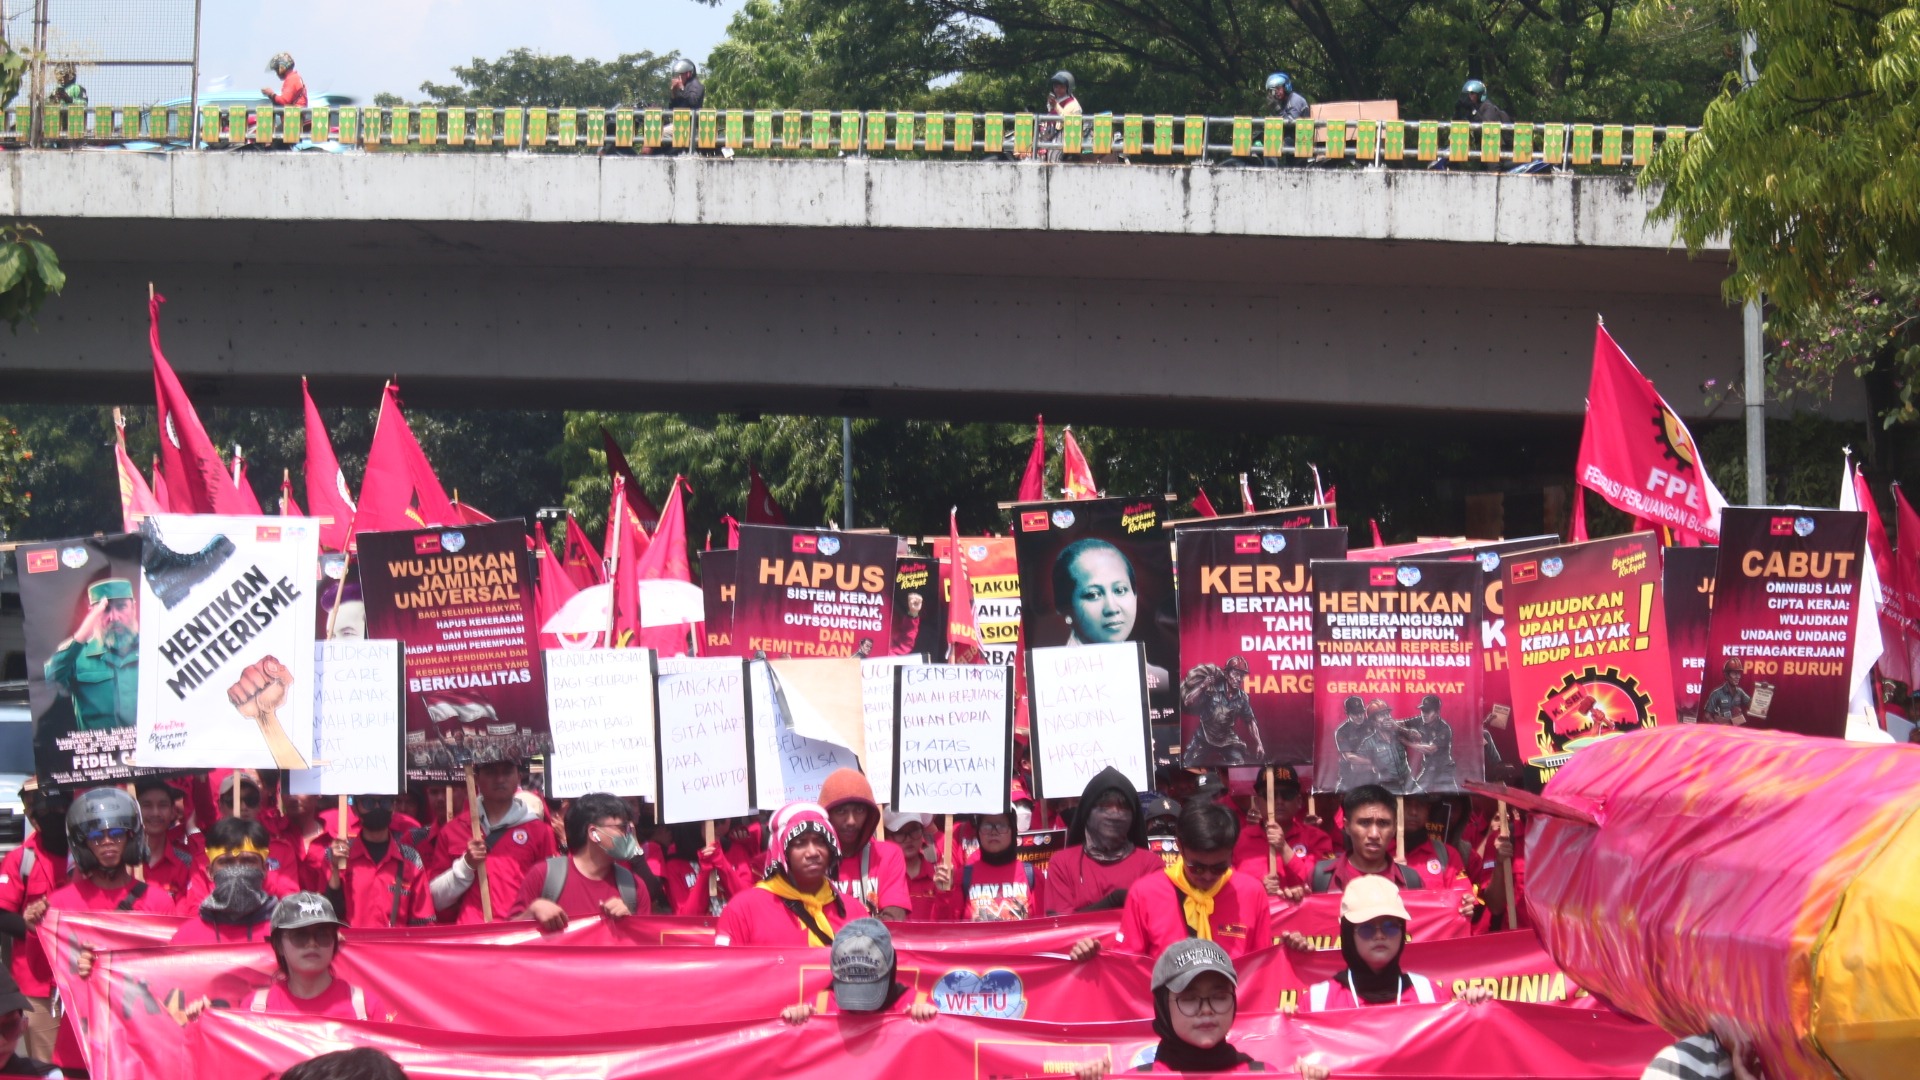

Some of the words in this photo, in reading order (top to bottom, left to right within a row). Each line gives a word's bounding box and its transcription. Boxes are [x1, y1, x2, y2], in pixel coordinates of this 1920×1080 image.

[1123, 502, 1152, 515] MayDay
[1621, 487, 1689, 527] PERJUANGAN
[1121, 510, 1156, 527] Bersama
[1128, 520, 1155, 534] Rakyat
[388, 551, 516, 578] WUJUDKAN
[1612, 551, 1648, 571] Bersama
[1618, 560, 1647, 579] Rakyat
[1742, 550, 1855, 578] CABUT
[418, 567, 518, 592] JAMINAN
[759, 557, 885, 593] HAPUS
[896, 570, 929, 583] Bersama
[901, 579, 927, 590] Rakyat
[1766, 582, 1823, 594] OMNIBUS
[1825, 582, 1852, 595] LAW
[394, 584, 520, 609] UNIVERSAL
[787, 587, 836, 603] SISTEM
[840, 591, 884, 606] KERJA
[1319, 591, 1471, 613] HENTIKAN
[1518, 590, 1625, 621] WUJUDKAN
[1768, 598, 1804, 610] CIPTA
[1807, 598, 1850, 611] KERJA:
[158, 564, 270, 667] HENTIKAN
[418, 610, 440, 620] BAGI
[441, 607, 483, 618] SELURUH
[813, 602, 883, 620] KONTRAK,
[1327, 613, 1464, 627] PEMBERANGUSAN
[1779, 614, 1848, 626] WUJUDKAN
[436, 619, 468, 630] HAPUS
[469, 614, 524, 627] KEKERASAN
[784, 613, 882, 631] OUTSOURCING
[1519, 615, 1565, 637] UPAH
[1568, 609, 1625, 631] LAYAK
[166, 575, 302, 701] MILITERISME
[442, 630, 462, 640] DAN
[463, 625, 525, 639] DISKRIMINASI
[819, 628, 855, 644] DAN
[1332, 627, 1397, 640] SERIKAT
[1401, 627, 1459, 642] BURUH,
[1520, 631, 1570, 652] KERJA
[1574, 623, 1632, 644] LAYAK
[1740, 629, 1792, 641] UNDANG
[1795, 630, 1847, 642] UNDANG
[435, 643, 468, 654] BURUH
[749, 637, 852, 658] KEMITRAAN
[1317, 640, 1397, 654] TINDAKAN
[1401, 641, 1474, 654] REPRESIF
[1522, 646, 1572, 667] HIDUP
[1574, 638, 1632, 659] LAYAK
[1722, 645, 1845, 658] KETENAGAKERJAAN
[406, 655, 450, 667] UJUDKAN
[452, 651, 507, 664] PENDIDIKAN
[509, 648, 529, 659] DAN
[550, 652, 604, 668] KEADILAN
[1055, 653, 1104, 678] UPAH
[1321, 654, 1352, 667] DAN
[1356, 654, 1471, 667] KRIMINALISASI
[334, 667, 383, 683] CARE
[415, 666, 469, 678] KESEHATAN
[470, 663, 502, 673] GRATIS
[505, 660, 530, 670] YANG
[907, 667, 960, 686] ESENSI
[1365, 668, 1426, 680] AKTIVIS
[1743, 660, 1779, 675] PRO
[1783, 661, 1843, 676] BURUH
[409, 669, 532, 693] BERKUALITAS
[553, 676, 581, 691] BAGI
[586, 673, 638, 688] SELURUH
[670, 675, 739, 701] TANGKAP
[1327, 681, 1400, 694] GERAKAN
[1405, 681, 1465, 694] RAKYAT
[348, 688, 392, 704] ANAK
[554, 695, 605, 712] RAKYAT
[904, 691, 945, 707] ADALAH
[949, 688, 1004, 705] BERJUANG
[1041, 684, 1111, 708] LAYAK
[694, 699, 724, 719] DAN
[351, 711, 396, 729] BURUH
[555, 719, 599, 735] BUKAN
[603, 715, 633, 730] BAGI
[903, 713, 945, 729] BUKAN
[949, 709, 992, 727] EVORIA
[1044, 708, 1126, 737] NASIONAL
[148, 731, 188, 745] Bersama
[671, 721, 707, 743] SITA
[557, 739, 609, 759] PEMILIK
[611, 736, 652, 751] MODAL
[925, 738, 971, 753] ATAS
[1047, 740, 1104, 766] HARGA
[73, 752, 117, 770] FIDEL
[666, 751, 703, 774] PARA
[789, 750, 839, 775] PULSA
[902, 756, 997, 776] PENDERITAAN
[557, 768, 597, 780] HIDUP
[601, 763, 640, 778] BURUH
[598, 777, 640, 790] RAKYAT
[904, 781, 982, 798] ANGGOTA
[969, 883, 999, 901] MAY
[1002, 882, 1028, 899] DAY
[945, 992, 1007, 1012] WFTU
